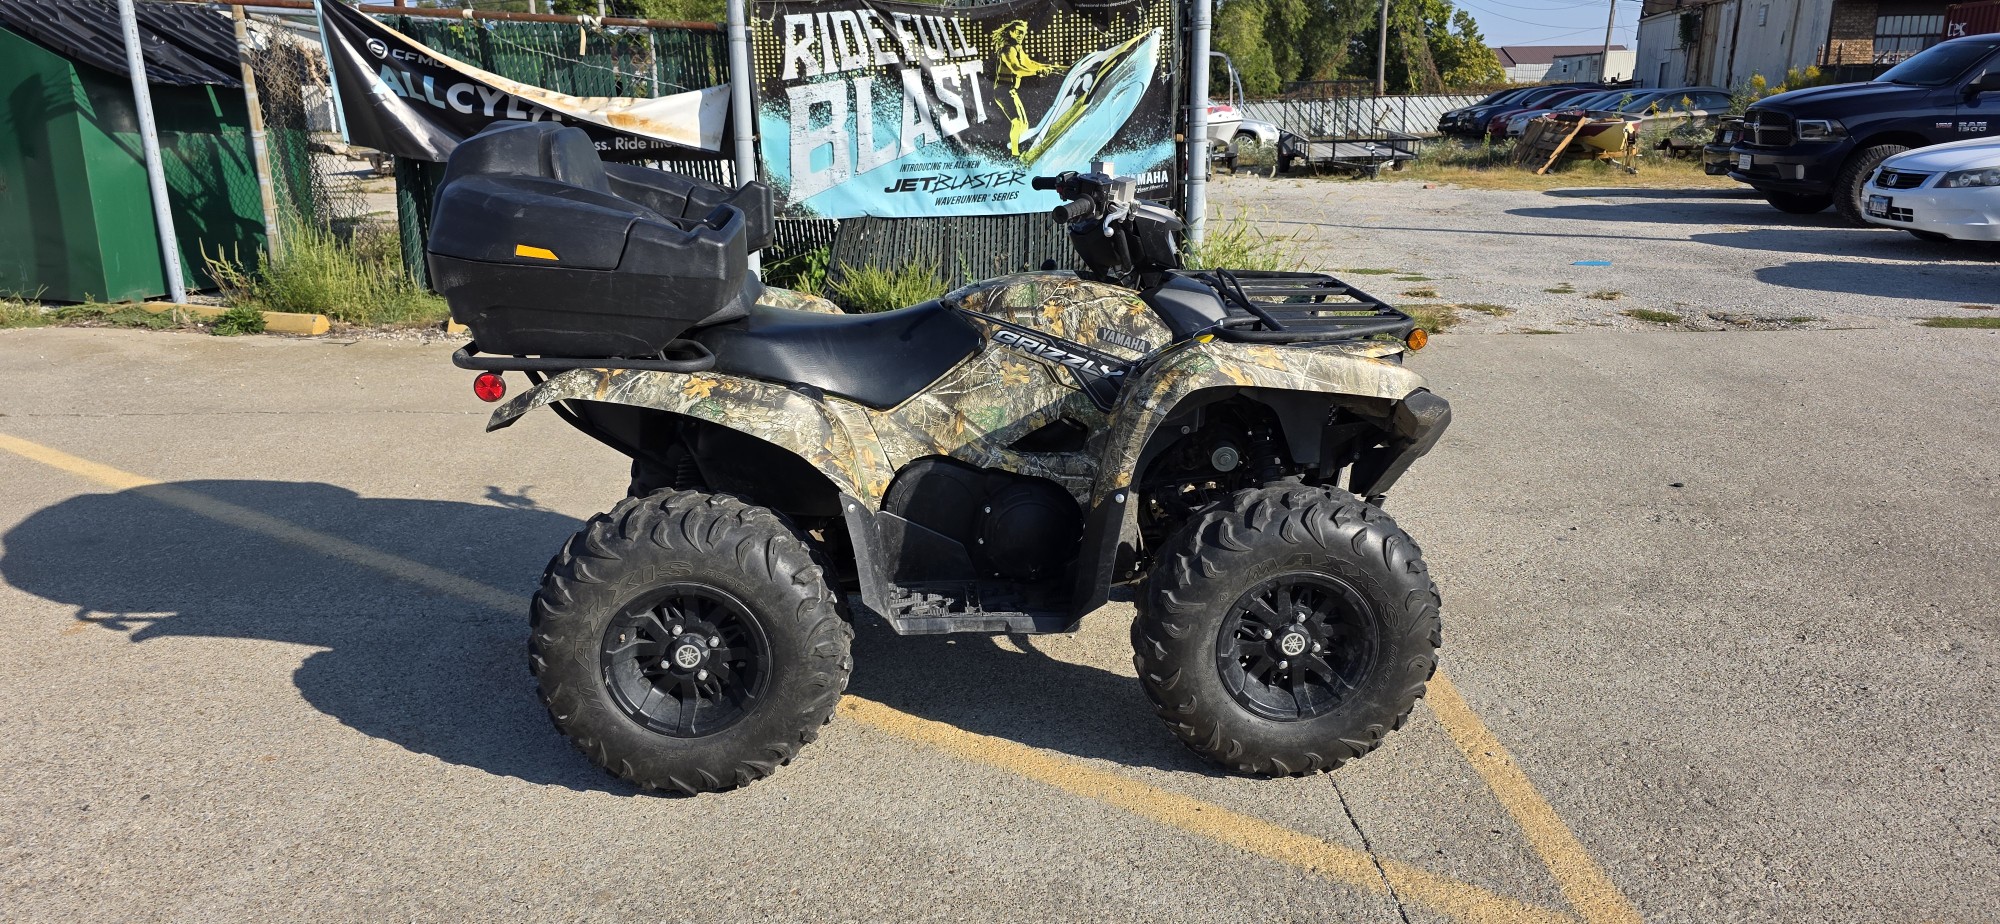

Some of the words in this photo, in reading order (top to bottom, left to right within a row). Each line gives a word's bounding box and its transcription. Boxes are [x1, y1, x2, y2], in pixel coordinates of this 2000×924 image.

[782, 9, 895, 80] RIDE
[889, 12, 979, 61] FULL
[374, 63, 446, 110] ALL
[446, 82, 562, 123] CYL
[594, 141, 612, 151] ss.
[615, 136, 647, 150] Ride
[785, 60, 988, 202] BLAST
[899, 161, 941, 173] INTRODUCING
[943, 162, 953, 170] THE
[954, 160, 980, 169] ALL-NEW
[1136, 170, 1169, 185] MAHA
[991, 190, 1020, 202] SERIES
[1101, 328, 1147, 353] YAMAHA
[990, 329, 1125, 379] GRIZZLY
